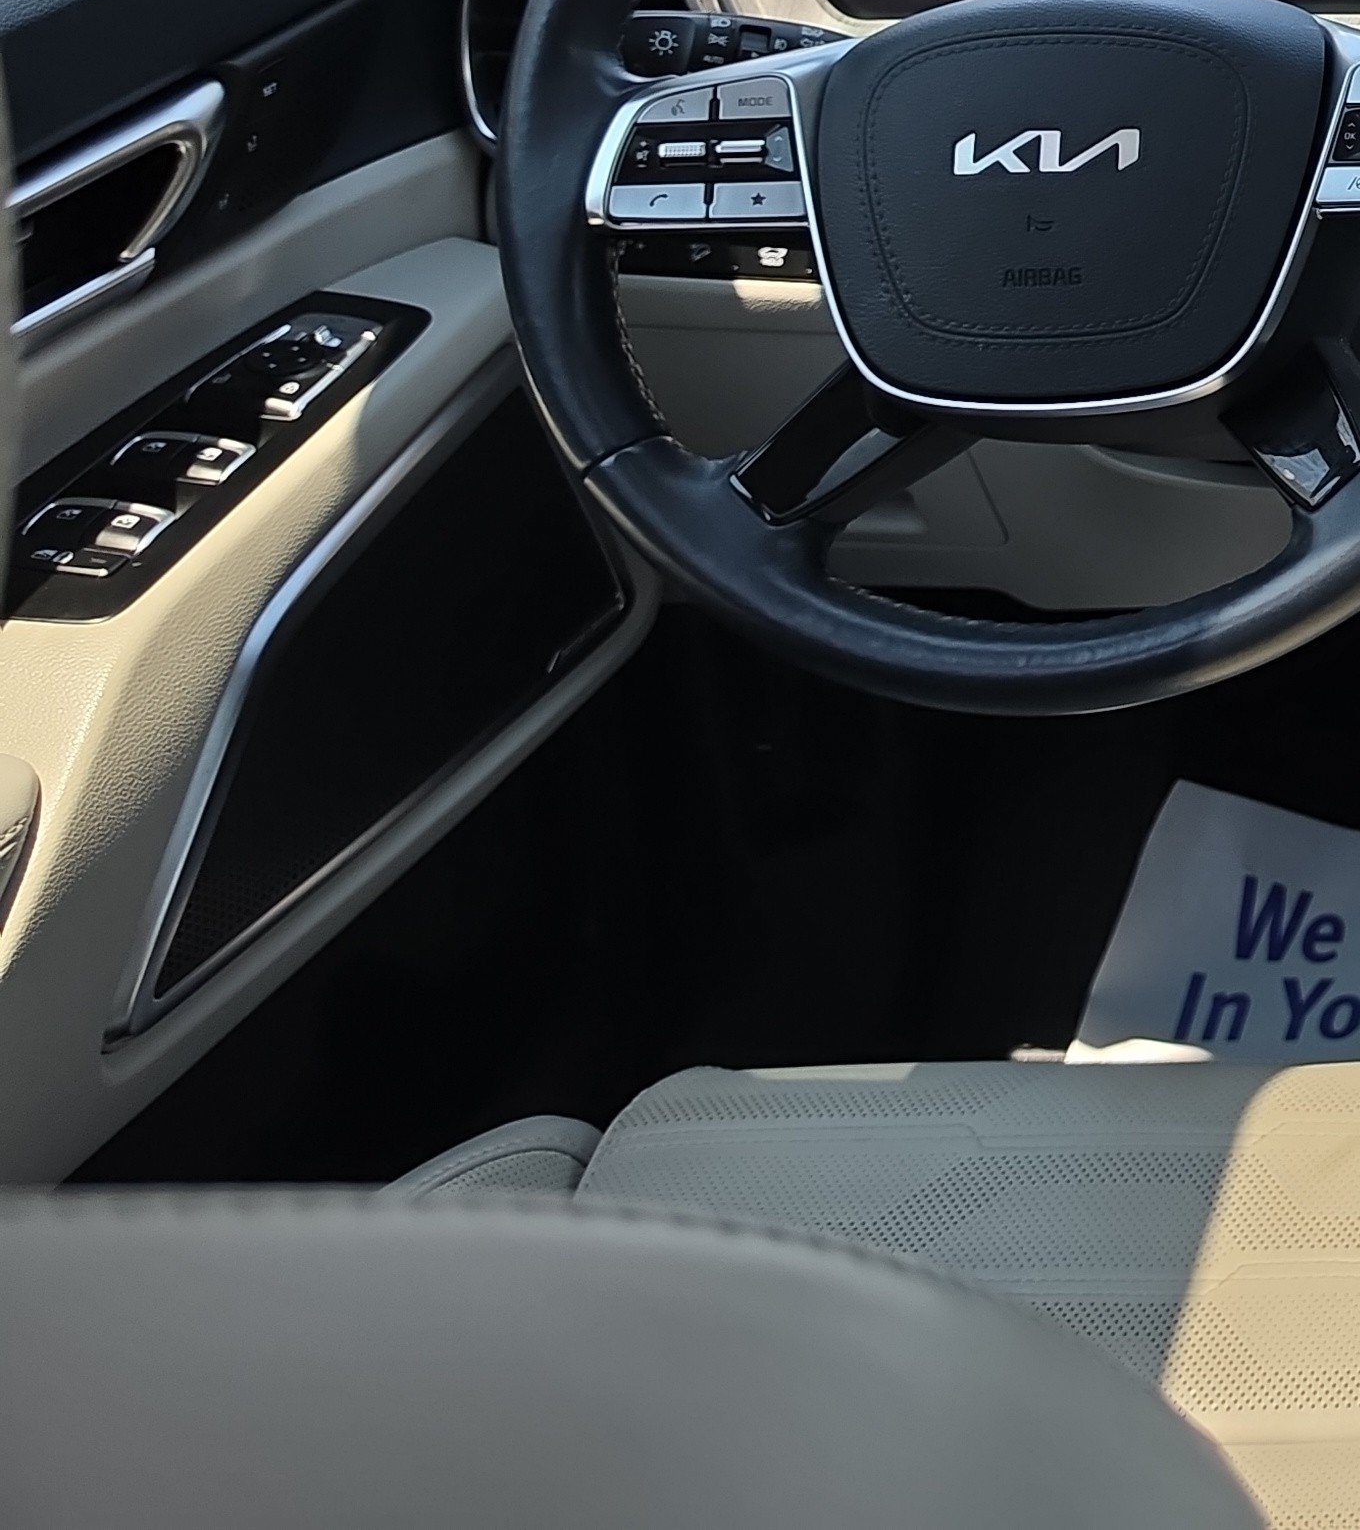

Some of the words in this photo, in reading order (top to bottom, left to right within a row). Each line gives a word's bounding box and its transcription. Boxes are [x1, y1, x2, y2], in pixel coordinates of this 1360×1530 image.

[703, 55, 724, 65] AUTO
[738, 96, 773, 108] MODE
[1344, 132, 1357, 141] OK
[953, 128, 1141, 176] KIA
[1002, 267, 1082, 288] AIRBAG
[1233, 872, 1346, 964] We
[1174, 971, 1253, 1043] In
